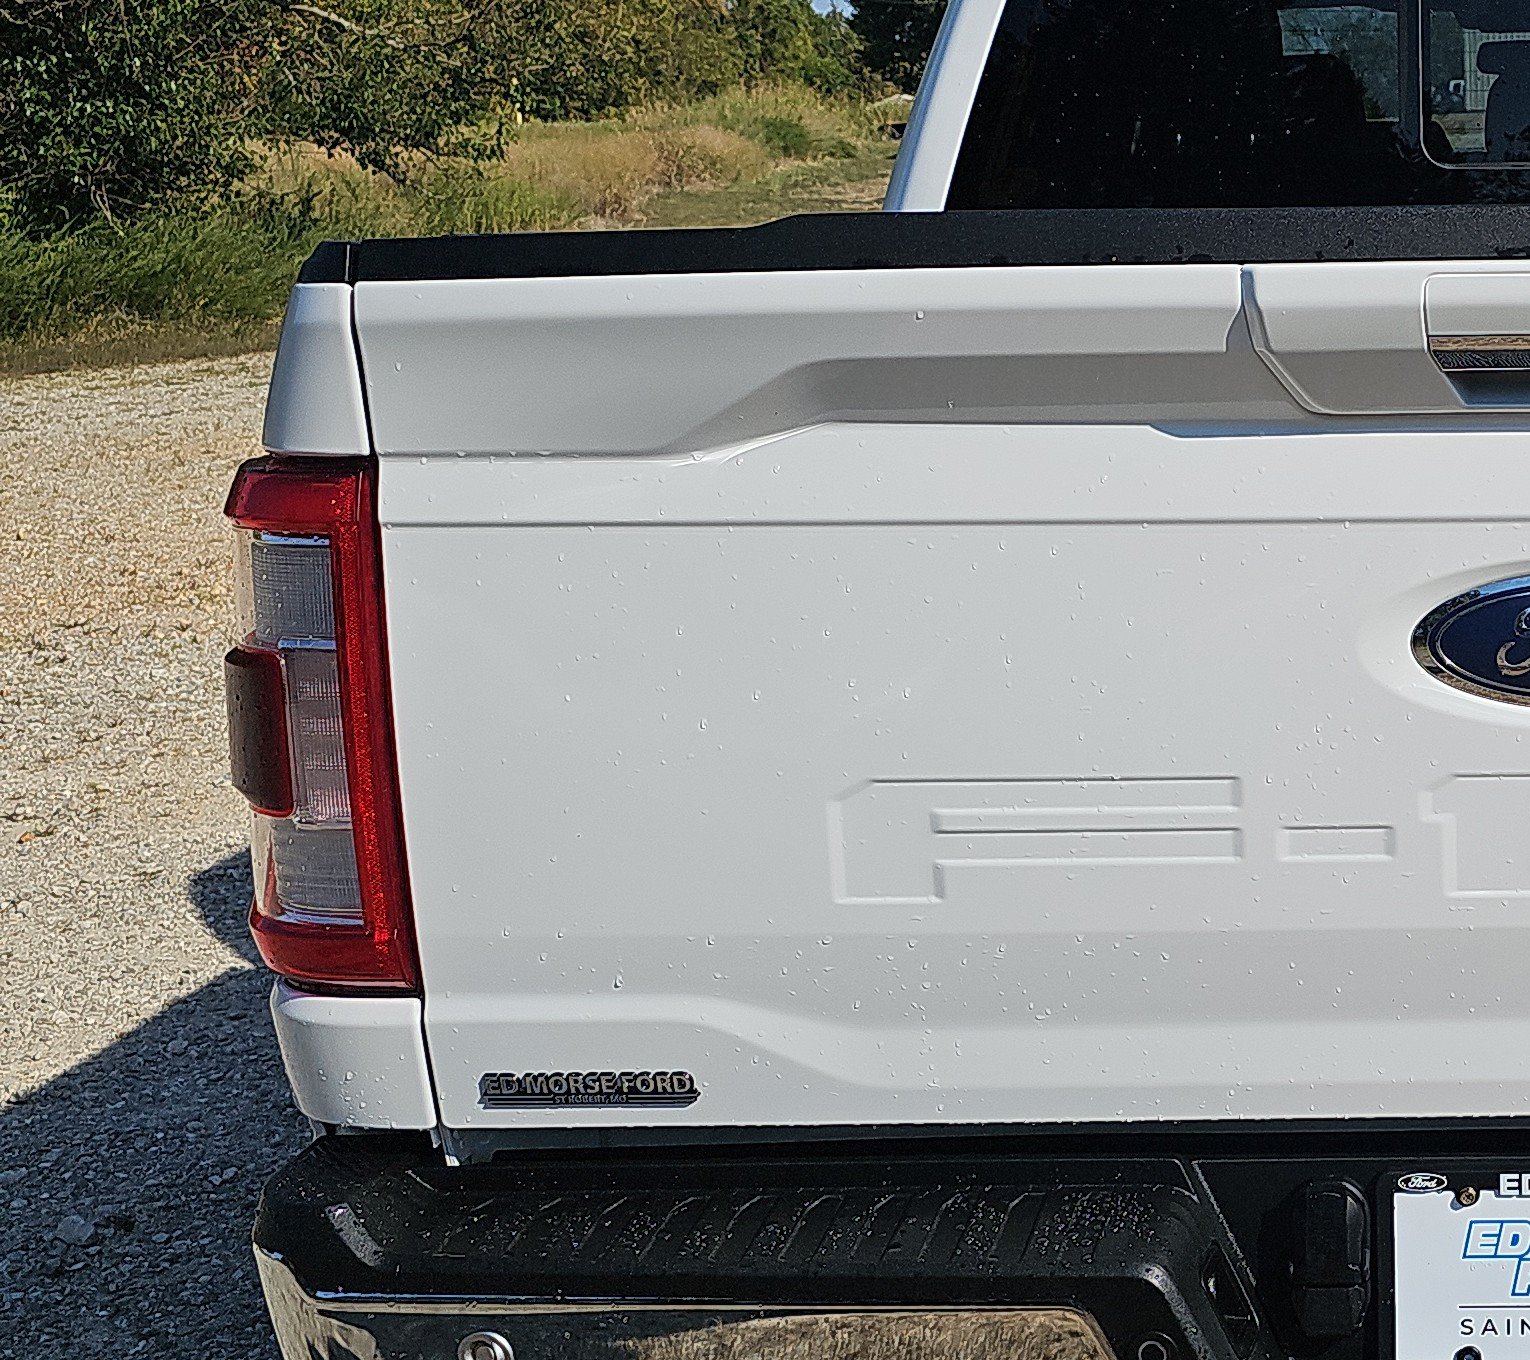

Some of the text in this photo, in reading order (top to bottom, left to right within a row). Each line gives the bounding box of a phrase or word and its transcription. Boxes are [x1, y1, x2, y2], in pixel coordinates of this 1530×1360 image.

[483, 1073, 692, 1094] ED MORSE FORD
